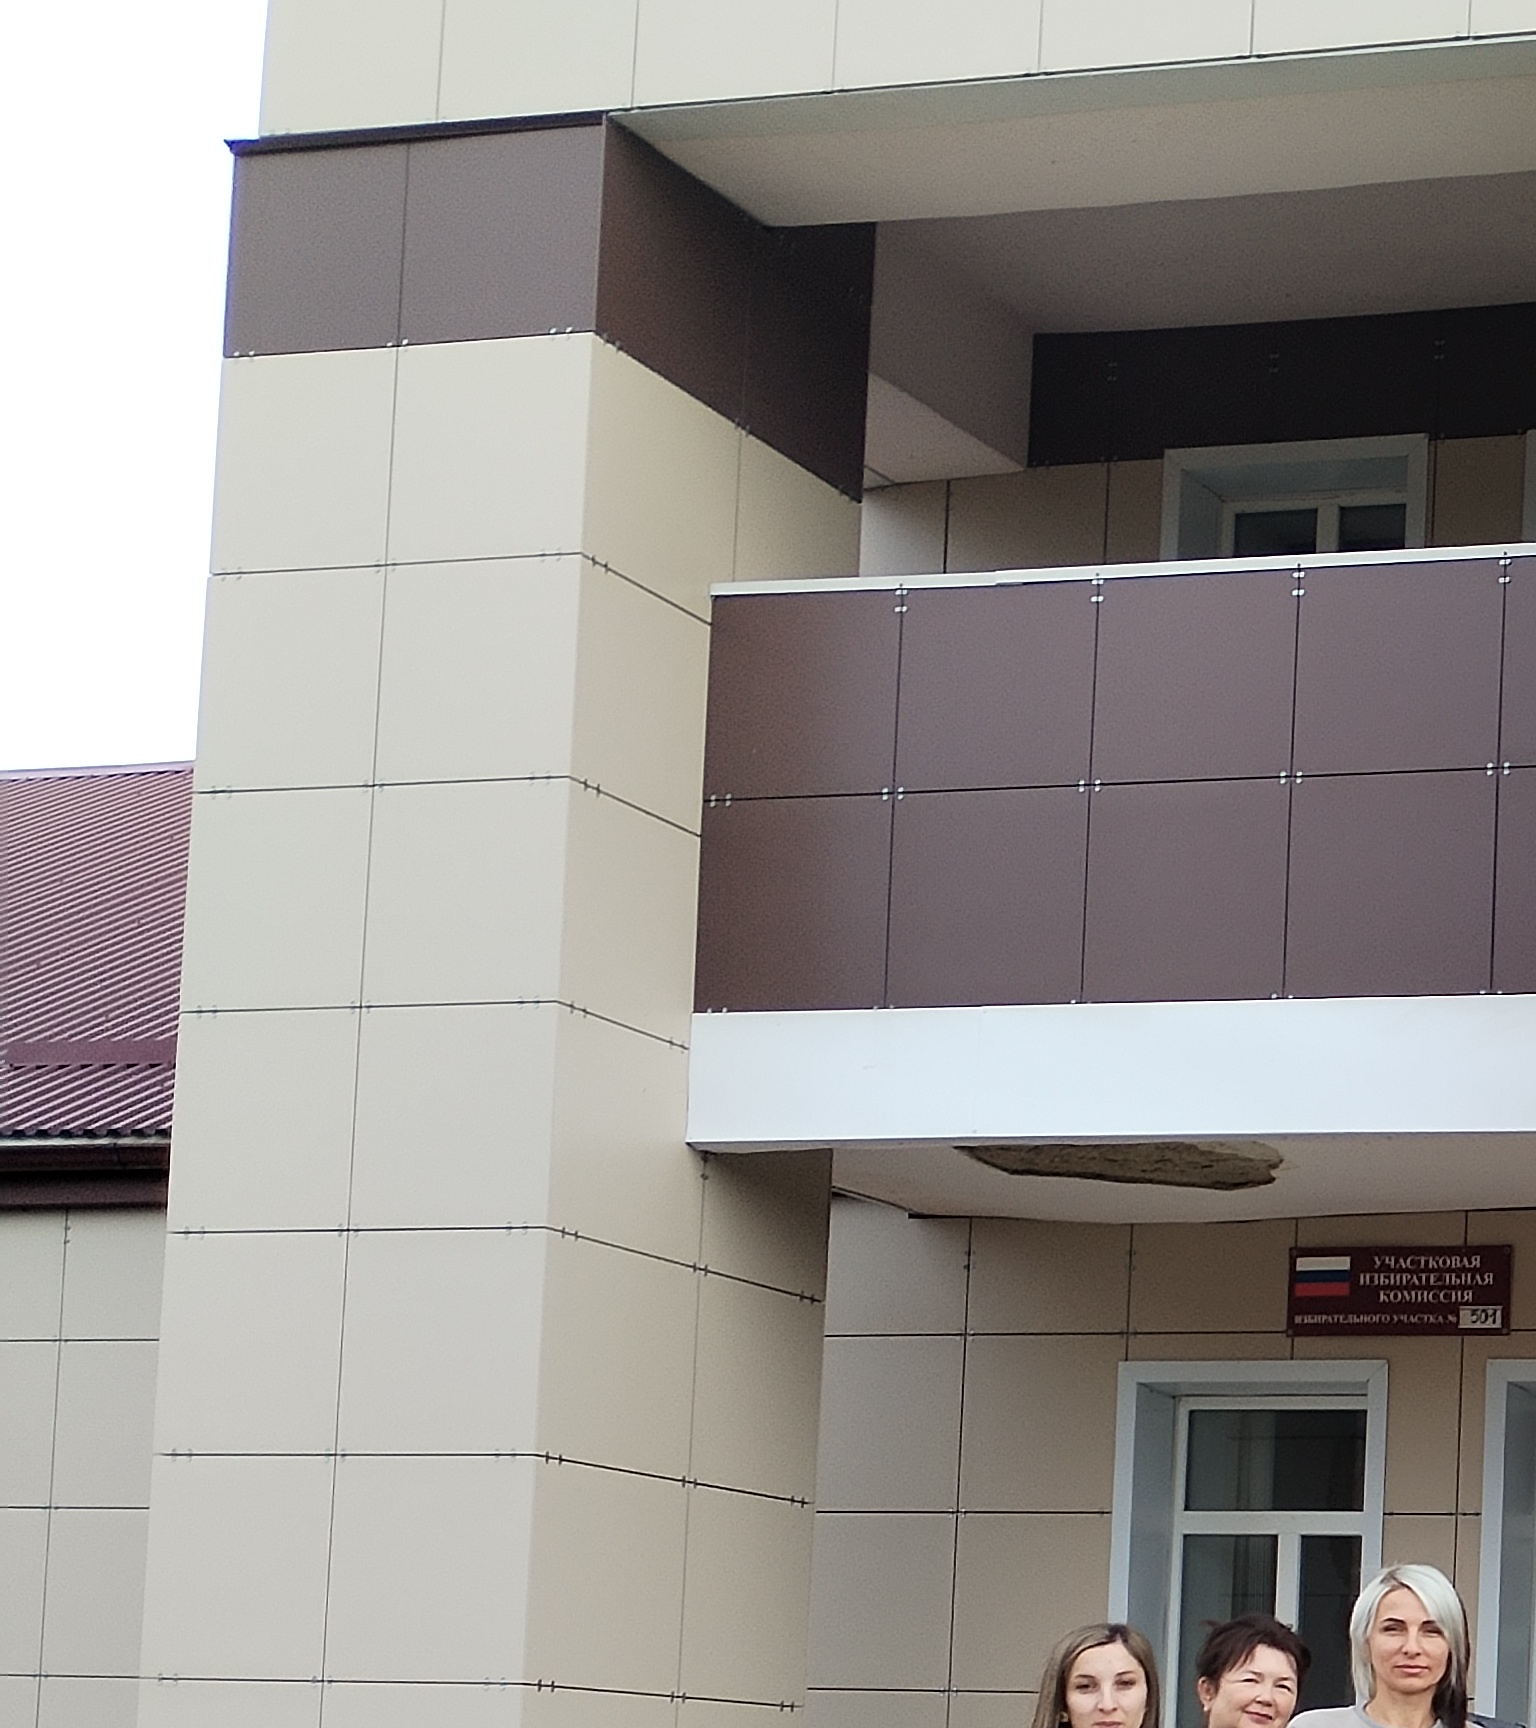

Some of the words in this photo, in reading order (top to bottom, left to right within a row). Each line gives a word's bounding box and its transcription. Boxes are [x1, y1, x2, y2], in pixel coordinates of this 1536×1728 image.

[1373, 1255, 1481, 1269] УЧАСТКОВАЯ
[1359, 1272, 1494, 1286] ИЗБИРАТЕЛЬНАЯ
[1379, 1289, 1474, 1303] КОМИССИЯ
[1294, 1314, 1391, 1325] ИЗБИРАТЕЛЬНОГО
[1393, 1313, 1444, 1324] УЧАСТКА
[1470, 1308, 1498, 1325] 501
